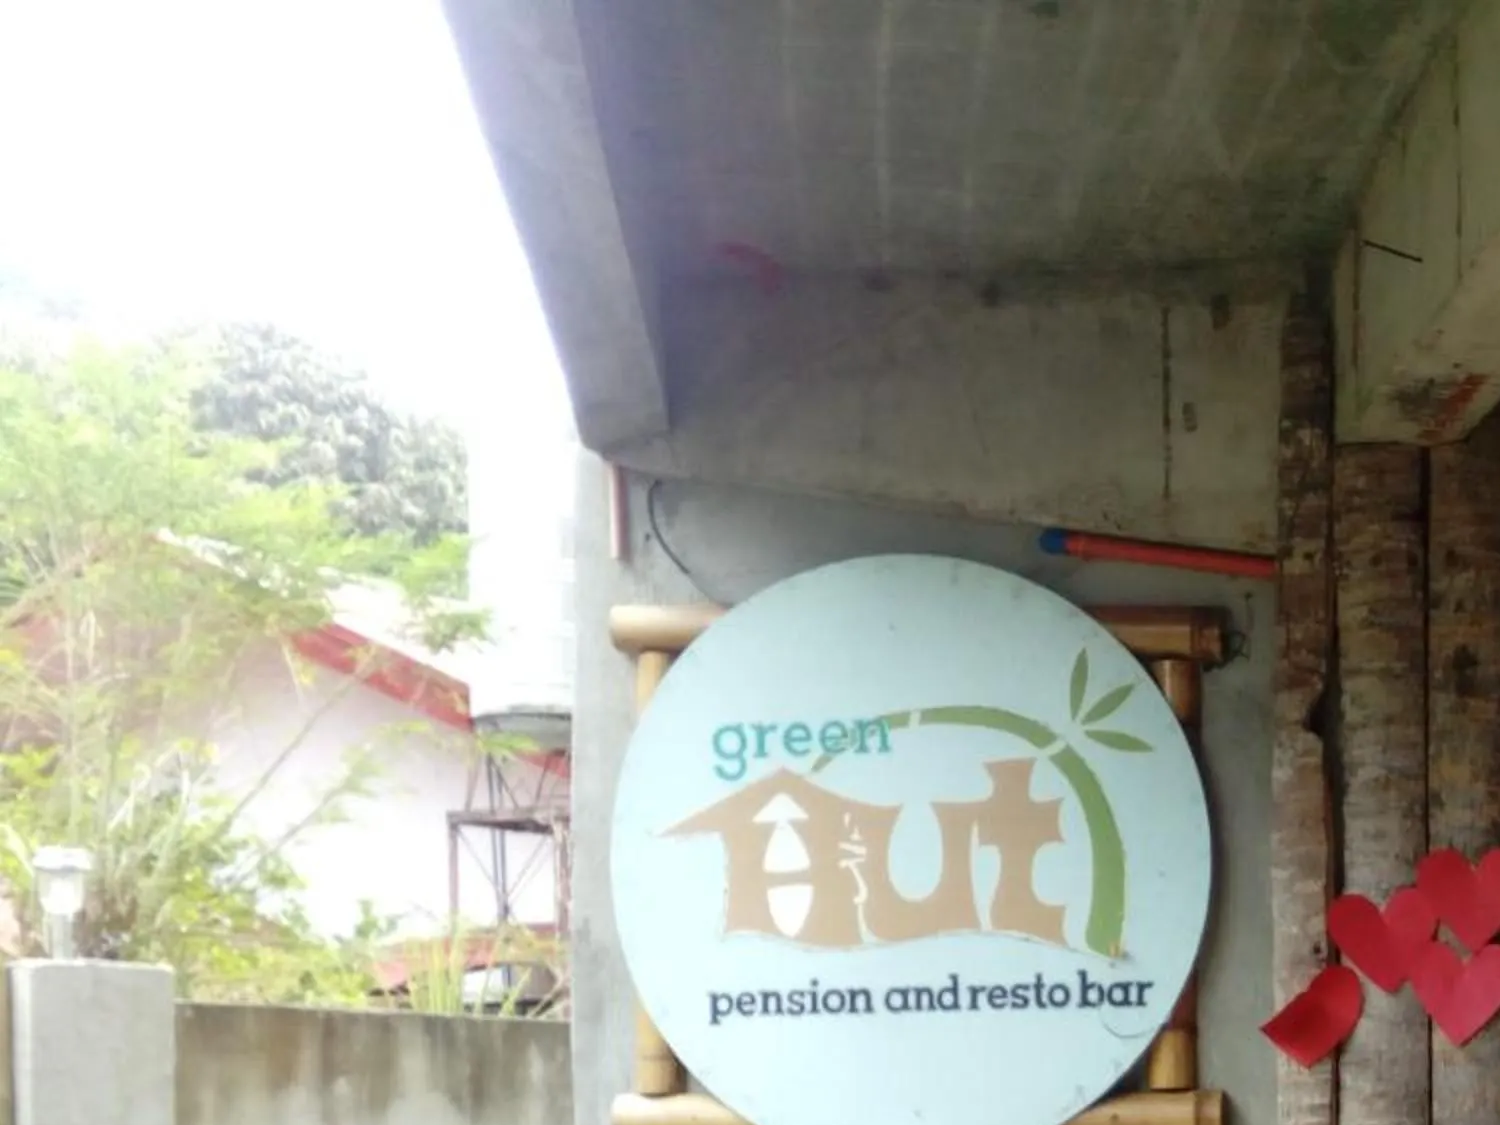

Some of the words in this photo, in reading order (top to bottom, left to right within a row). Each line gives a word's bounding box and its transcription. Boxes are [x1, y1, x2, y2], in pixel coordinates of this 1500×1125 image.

[711, 716, 892, 781] green
[707, 978, 876, 1025] pension
[884, 972, 961, 1012] and
[966, 971, 1072, 1011] resto
[1076, 968, 1155, 1009] bar
